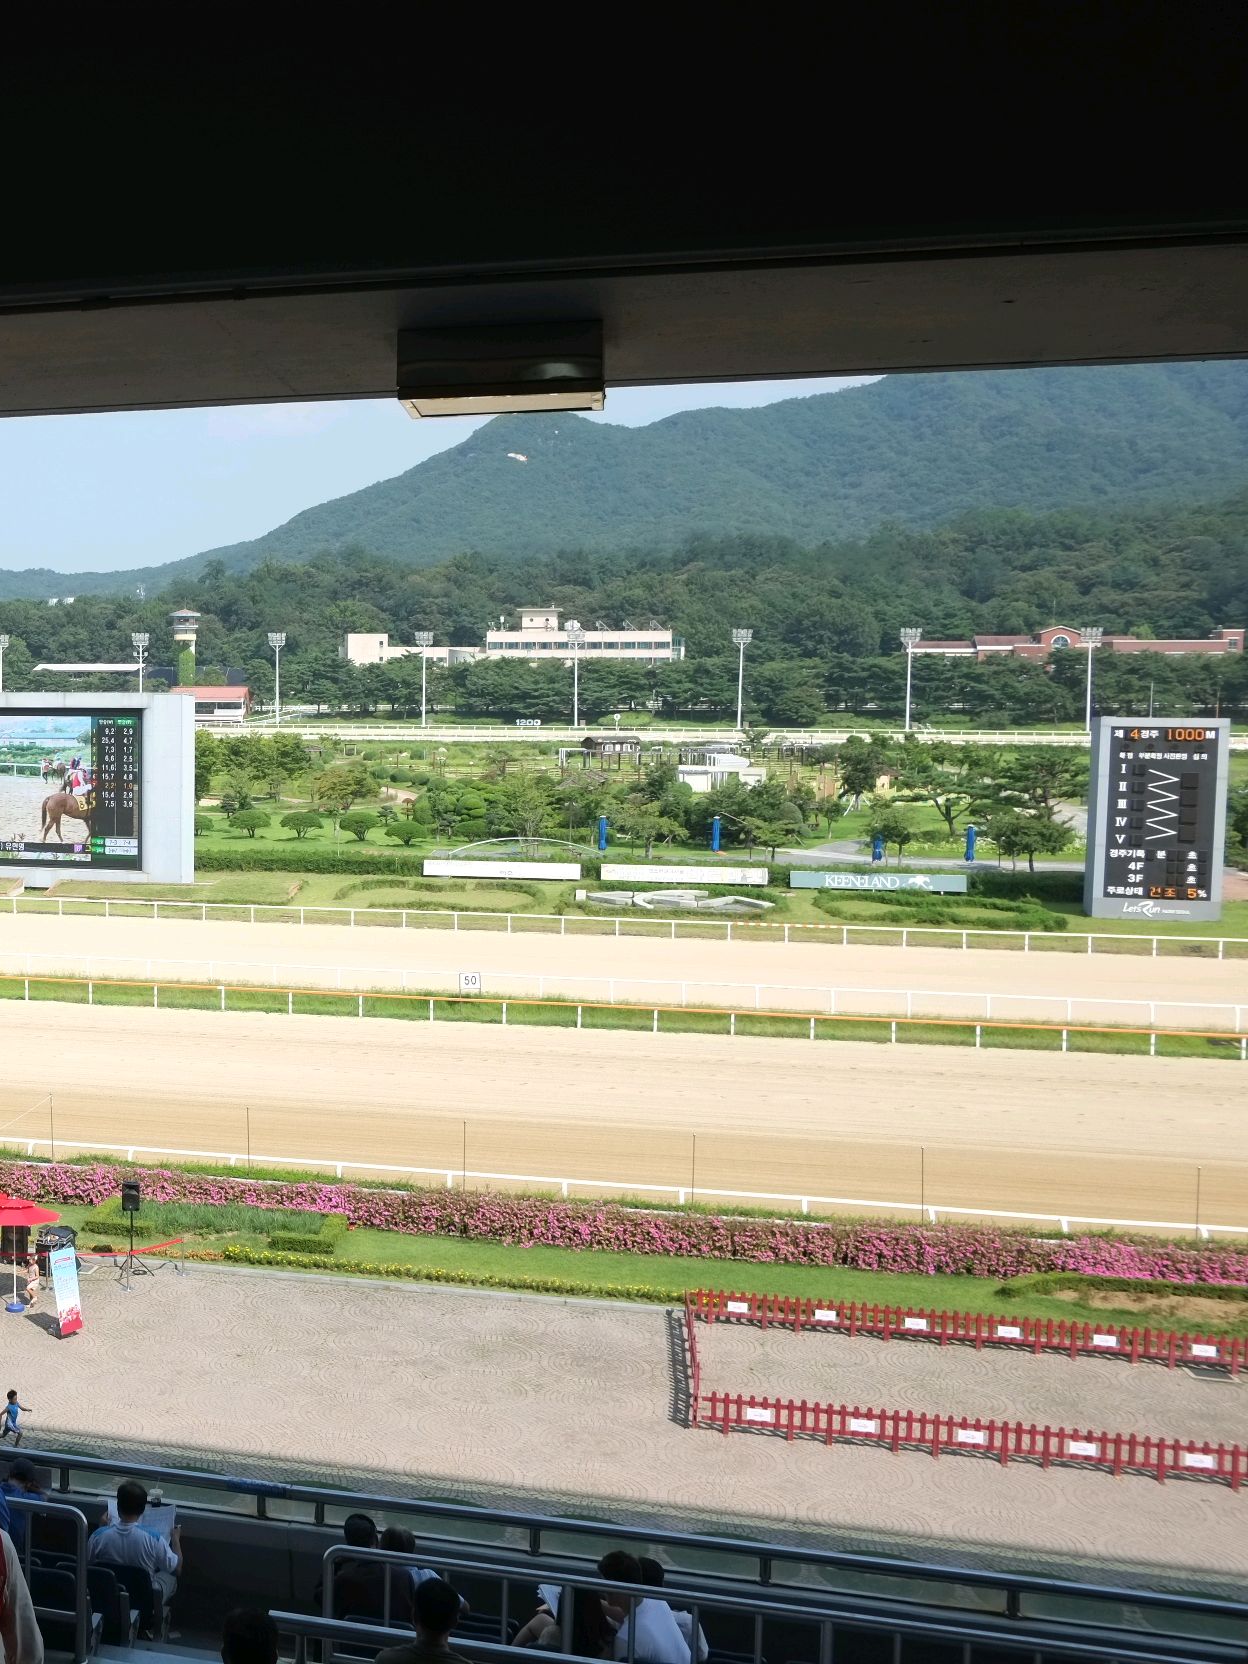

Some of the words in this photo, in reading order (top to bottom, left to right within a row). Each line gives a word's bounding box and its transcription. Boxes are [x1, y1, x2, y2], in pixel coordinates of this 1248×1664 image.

[1114, 730, 1124, 738] 제
[1110, 849, 1145, 858] 경주기록
[1186, 851, 1197, 859] 초
[1128, 862, 1144, 870] 4F
[825, 875, 900, 888] KEENELAND
[1128, 874, 1143, 882] 3F
[1107, 886, 1143, 895] 주로상태
[464, 976, 477, 985] 50
